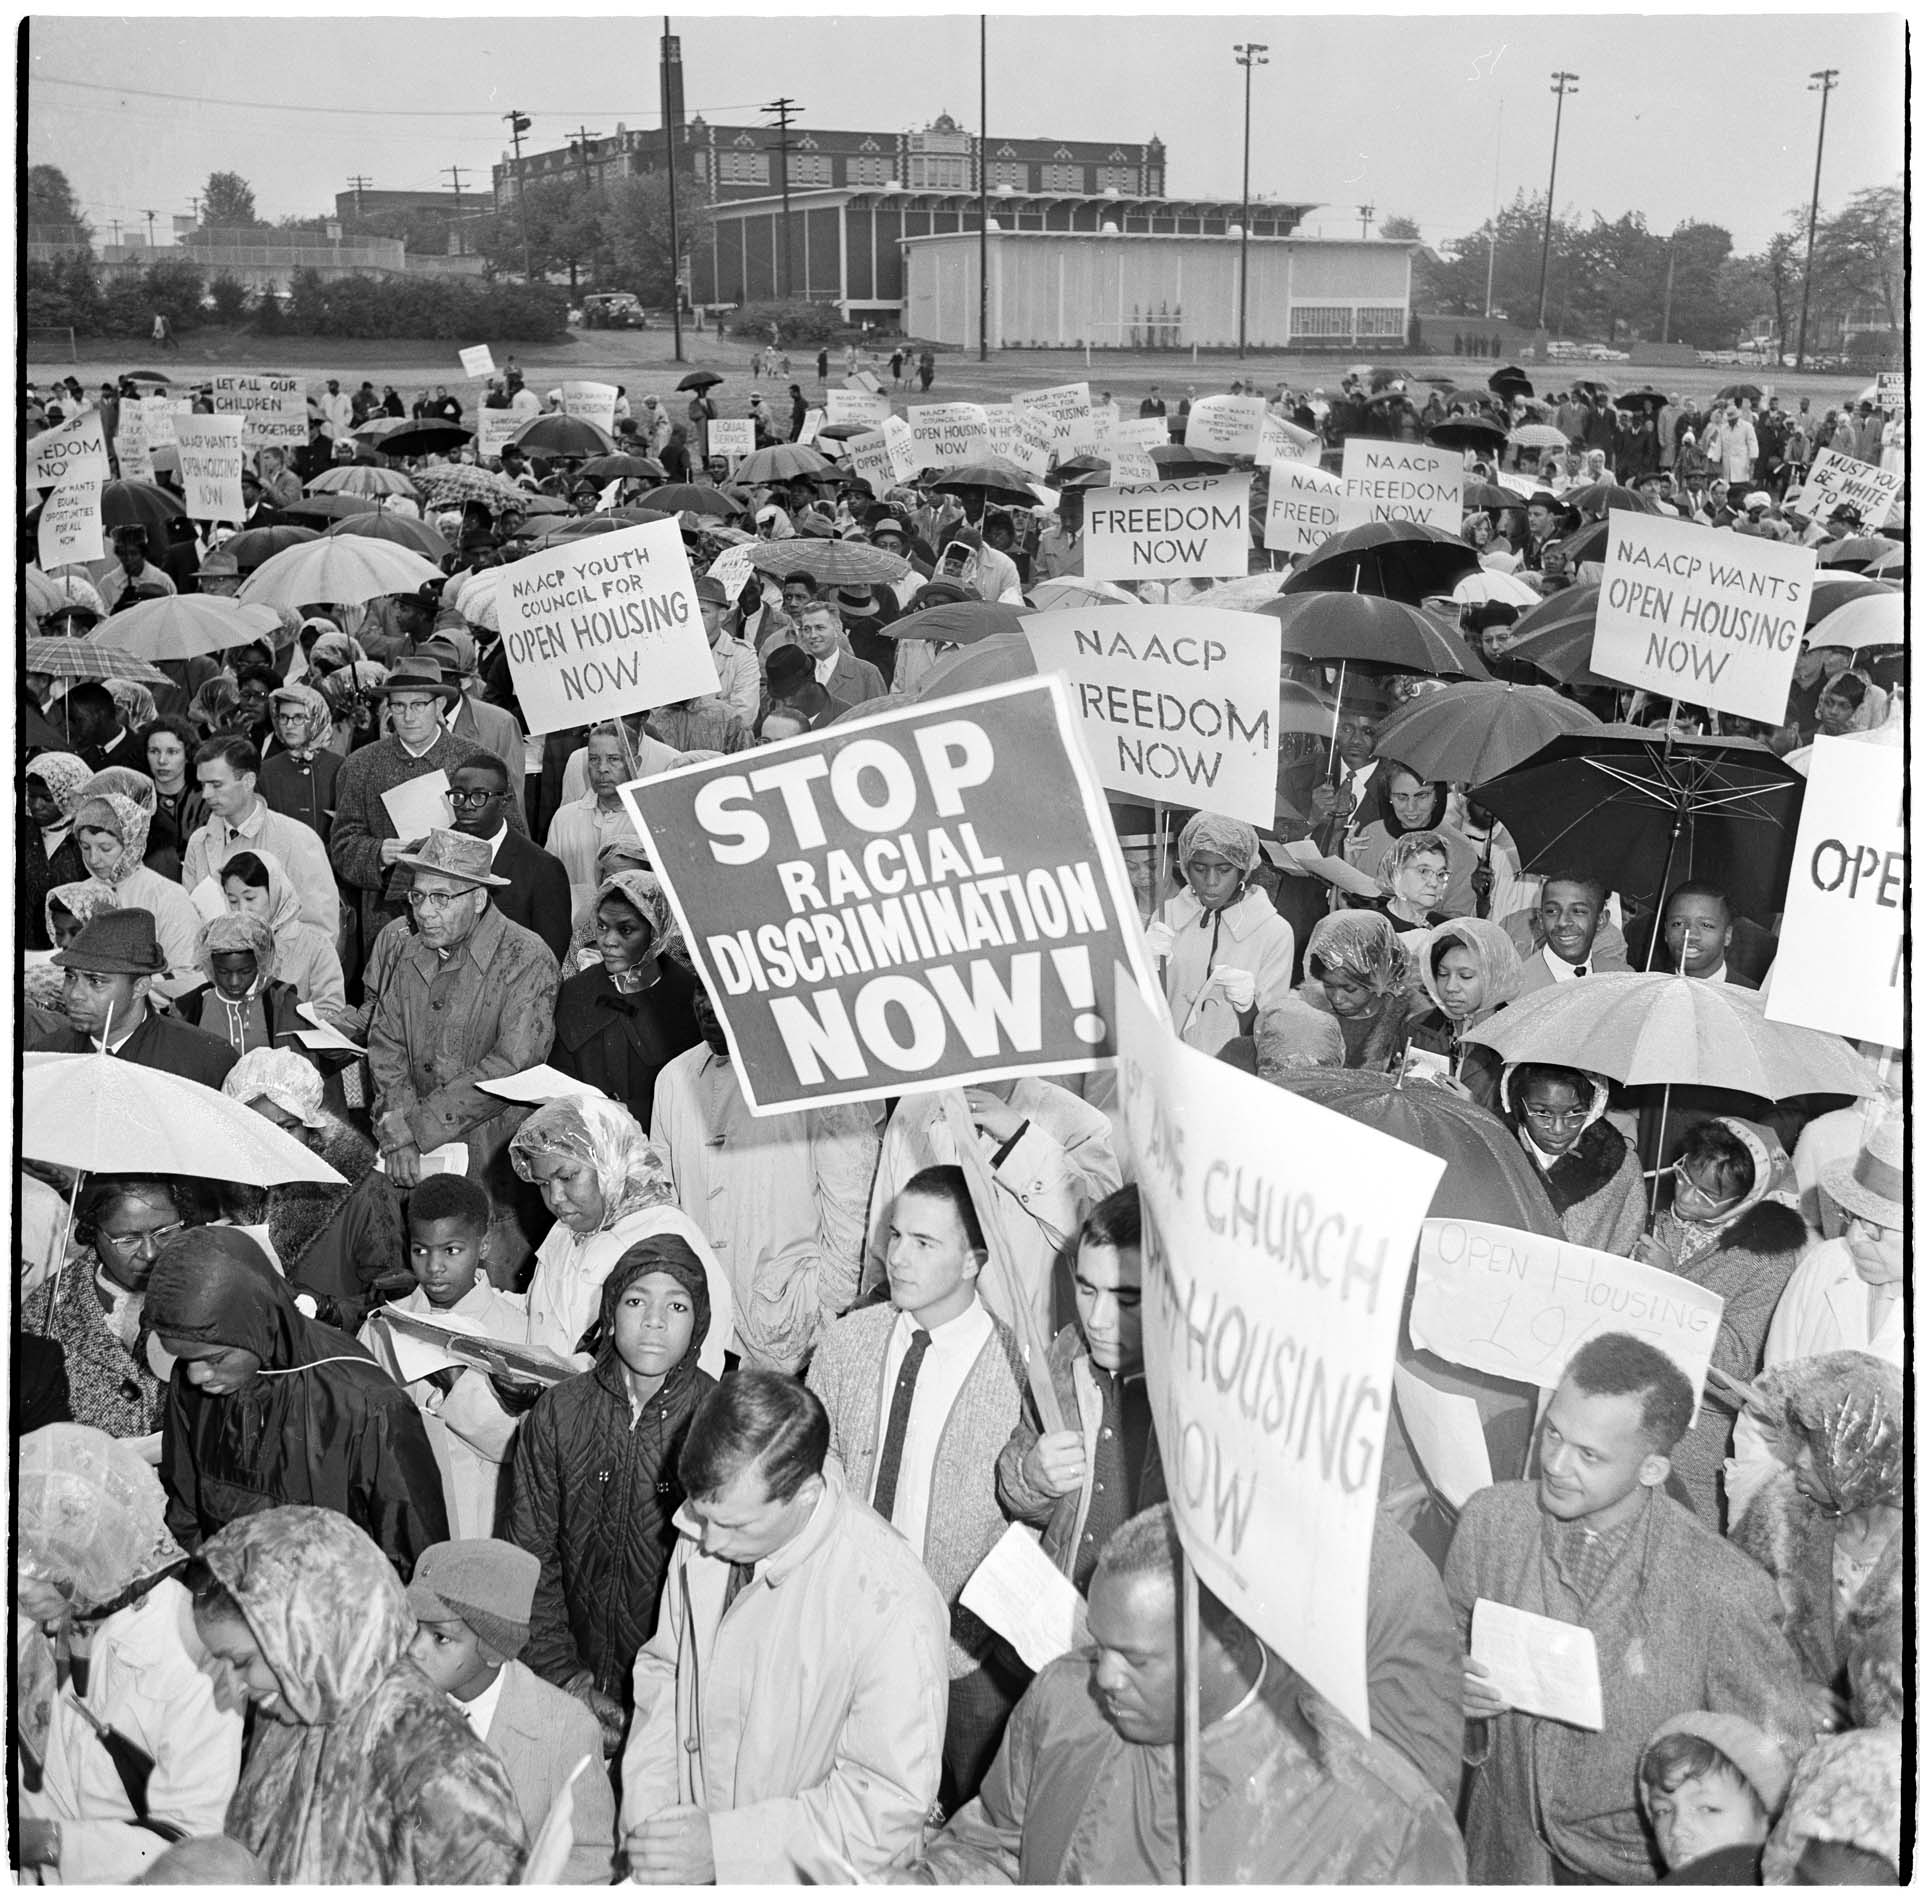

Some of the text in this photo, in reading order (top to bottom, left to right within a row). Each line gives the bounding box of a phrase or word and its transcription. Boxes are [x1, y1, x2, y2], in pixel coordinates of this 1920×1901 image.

[216, 378, 296, 392] LET ALL OUR
[1883, 374, 1904, 384] STO
[216, 396, 282, 411] CHILDREN
[1023, 390, 1079, 403] NAACP YOUTH
[919, 409, 946, 417] NAACP
[922, 414, 955, 424] COUNCIL
[1228, 408, 1256, 416] WANTS
[249, 422, 305, 436] TOGETHER
[716, 421, 746, 432] EQUAL
[913, 426, 940, 440] OPEN
[944, 422, 987, 438] HOUSING
[205, 435, 238, 449] WANTS
[713, 434, 750, 444] SERVICE
[1262, 431, 1294, 443] FREE
[889, 439, 912, 456] FREE
[935, 440, 968, 455] NOW
[990, 442, 1010, 454] NO
[1275, 446, 1304, 458] NOW
[857, 455, 882, 470] OPEN
[1367, 453, 1441, 473] NAACP
[1826, 454, 1902, 490] MUST YOU
[879, 466, 895, 480] NO
[199, 484, 223, 506] NOW
[1118, 479, 1219, 495] NAACP
[1291, 475, 1341, 497] NAAC
[1346, 478, 1459, 504] FREEDOM
[1814, 469, 1888, 507] BE WHITE
[57, 496, 79, 507] EQUAL
[1818, 488, 1838, 505] TO
[45, 507, 95, 522] OPPORTUNITIES
[1092, 505, 1241, 534] FREEDOM
[1272, 500, 1340, 527] FREED
[1375, 504, 1433, 525] NOW
[1807, 503, 1820, 517] A
[56, 523, 82, 533] FOR ALL
[1298, 527, 1331, 547] NO
[60, 536, 75, 545] NOW
[1133, 538, 1208, 564] NOW
[512, 547, 650, 598] NAACP YOUTH
[1617, 539, 1801, 602] NAACP WANTS
[521, 574, 644, 618] COUNCIL FOR
[1609, 578, 1796, 652] OPEN HOUSING
[508, 591, 689, 664] OPEN HOUSING
[1073, 630, 1227, 671] NAACP
[1645, 632, 1731, 684] NOW
[560, 650, 639, 701] NOW
[1071, 683, 1269, 749] REEDOM
[1117, 735, 1222, 787] NOW
[693, 718, 995, 867] STOP
[777, 821, 1004, 914] RACIAL
[1811, 838, 1904, 908] OPE
[706, 860, 1109, 997] DISCRIMINATION
[768, 943, 1107, 1086] NOW!
[1203, 1159, 1389, 1315] CHURCH
[1438, 1222, 1529, 1281] OPEN
[1184, 1276, 1383, 1496] HOUSING
